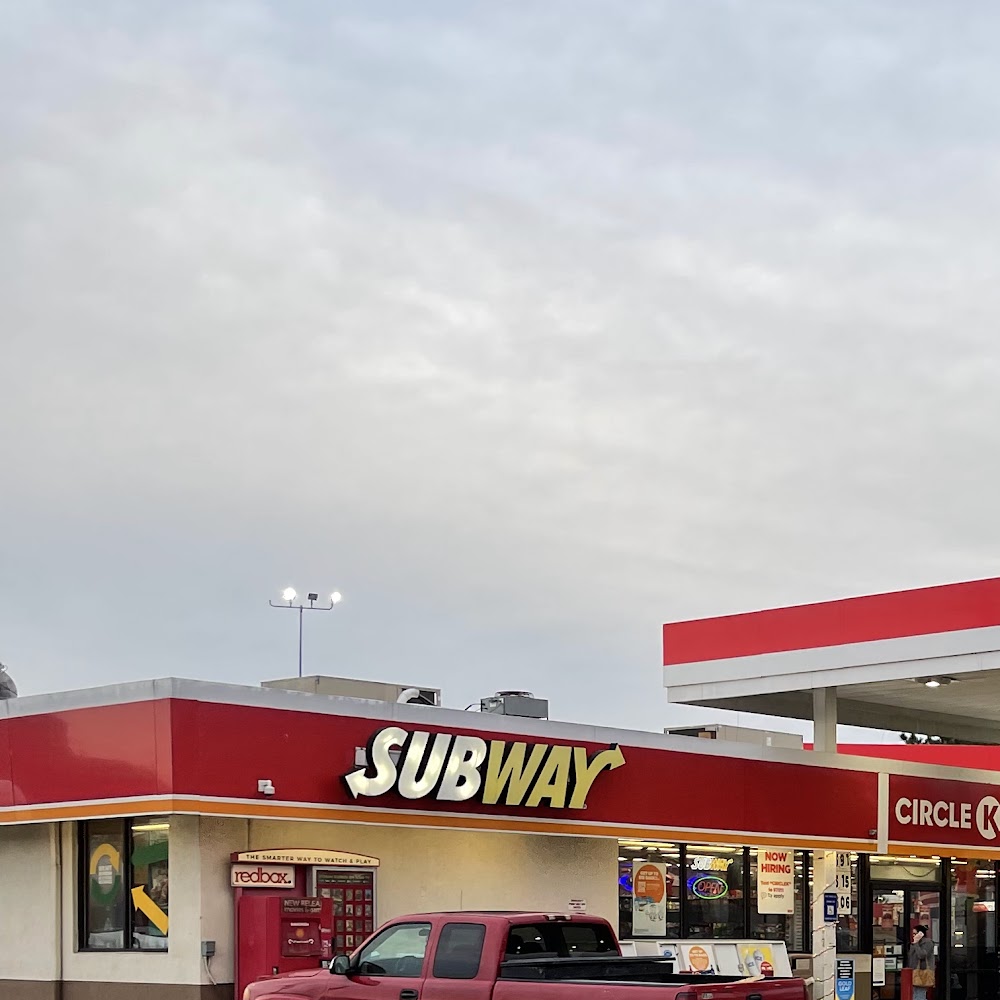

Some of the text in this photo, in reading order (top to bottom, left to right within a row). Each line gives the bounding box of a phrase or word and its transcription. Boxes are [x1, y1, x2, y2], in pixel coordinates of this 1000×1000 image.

[345, 727, 626, 809] SUBWAY
[895, 797, 1000, 838] CIRCLE K
[690, 856, 734, 871] SUBWAY
[765, 852, 787, 862] NOW
[234, 867, 292, 884] redbox.
[761, 863, 791, 874] HIRING
[697, 881, 722, 895] OPEN
